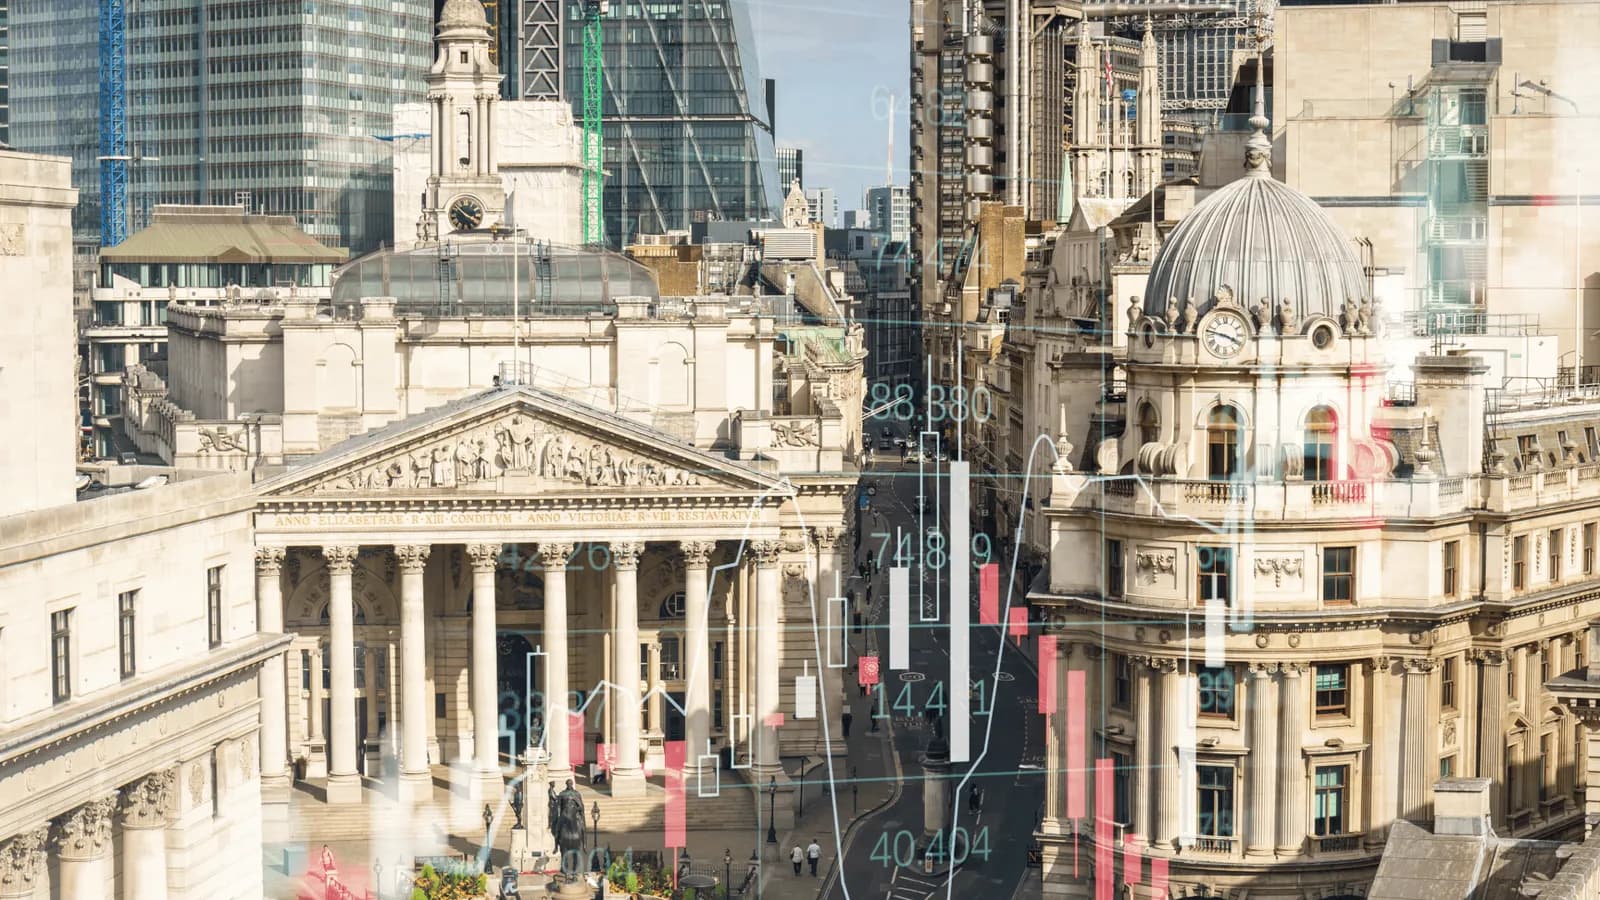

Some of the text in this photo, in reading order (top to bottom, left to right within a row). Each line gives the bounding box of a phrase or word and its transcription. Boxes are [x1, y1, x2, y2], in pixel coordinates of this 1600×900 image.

[276, 510, 761, 526] ANNO ELIZABETHAE R XIII CONDITVM ANNO VICTORIAE R VIII RESTAVRATVM
